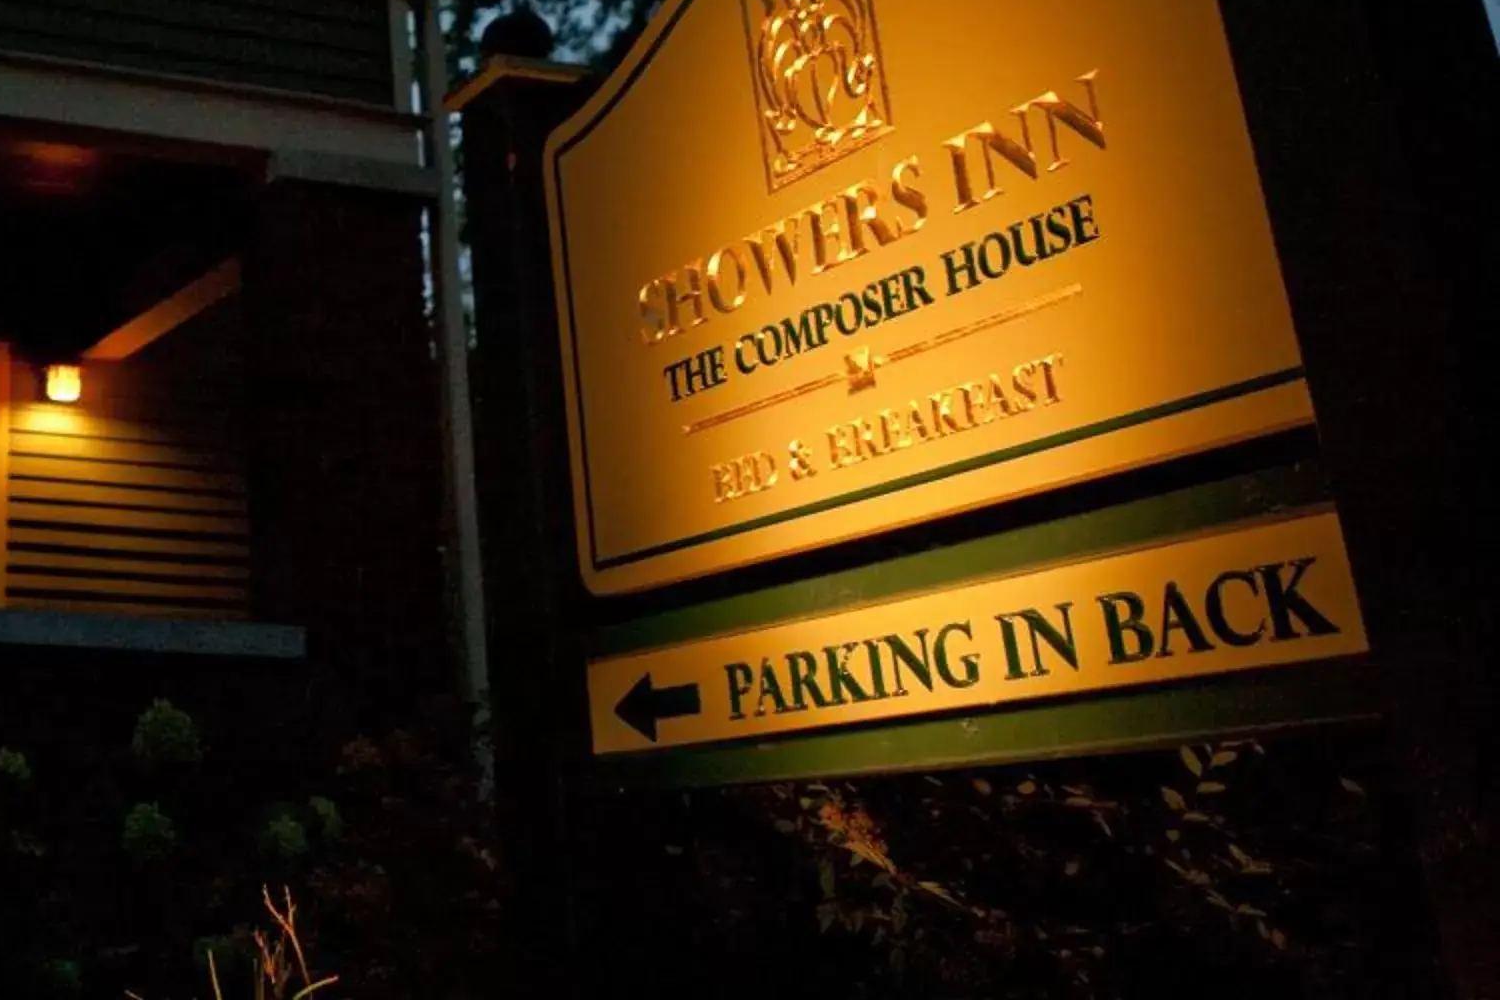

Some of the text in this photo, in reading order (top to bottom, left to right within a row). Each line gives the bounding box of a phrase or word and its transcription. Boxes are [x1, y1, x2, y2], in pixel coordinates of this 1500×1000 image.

[639, 68, 1107, 345] SHOWERS INN
[663, 194, 1101, 402] THE COMPOSER HOUSE
[708, 351, 1067, 504] BED & BREAKFAST
[724, 555, 1341, 721] PARKING IN BACK
